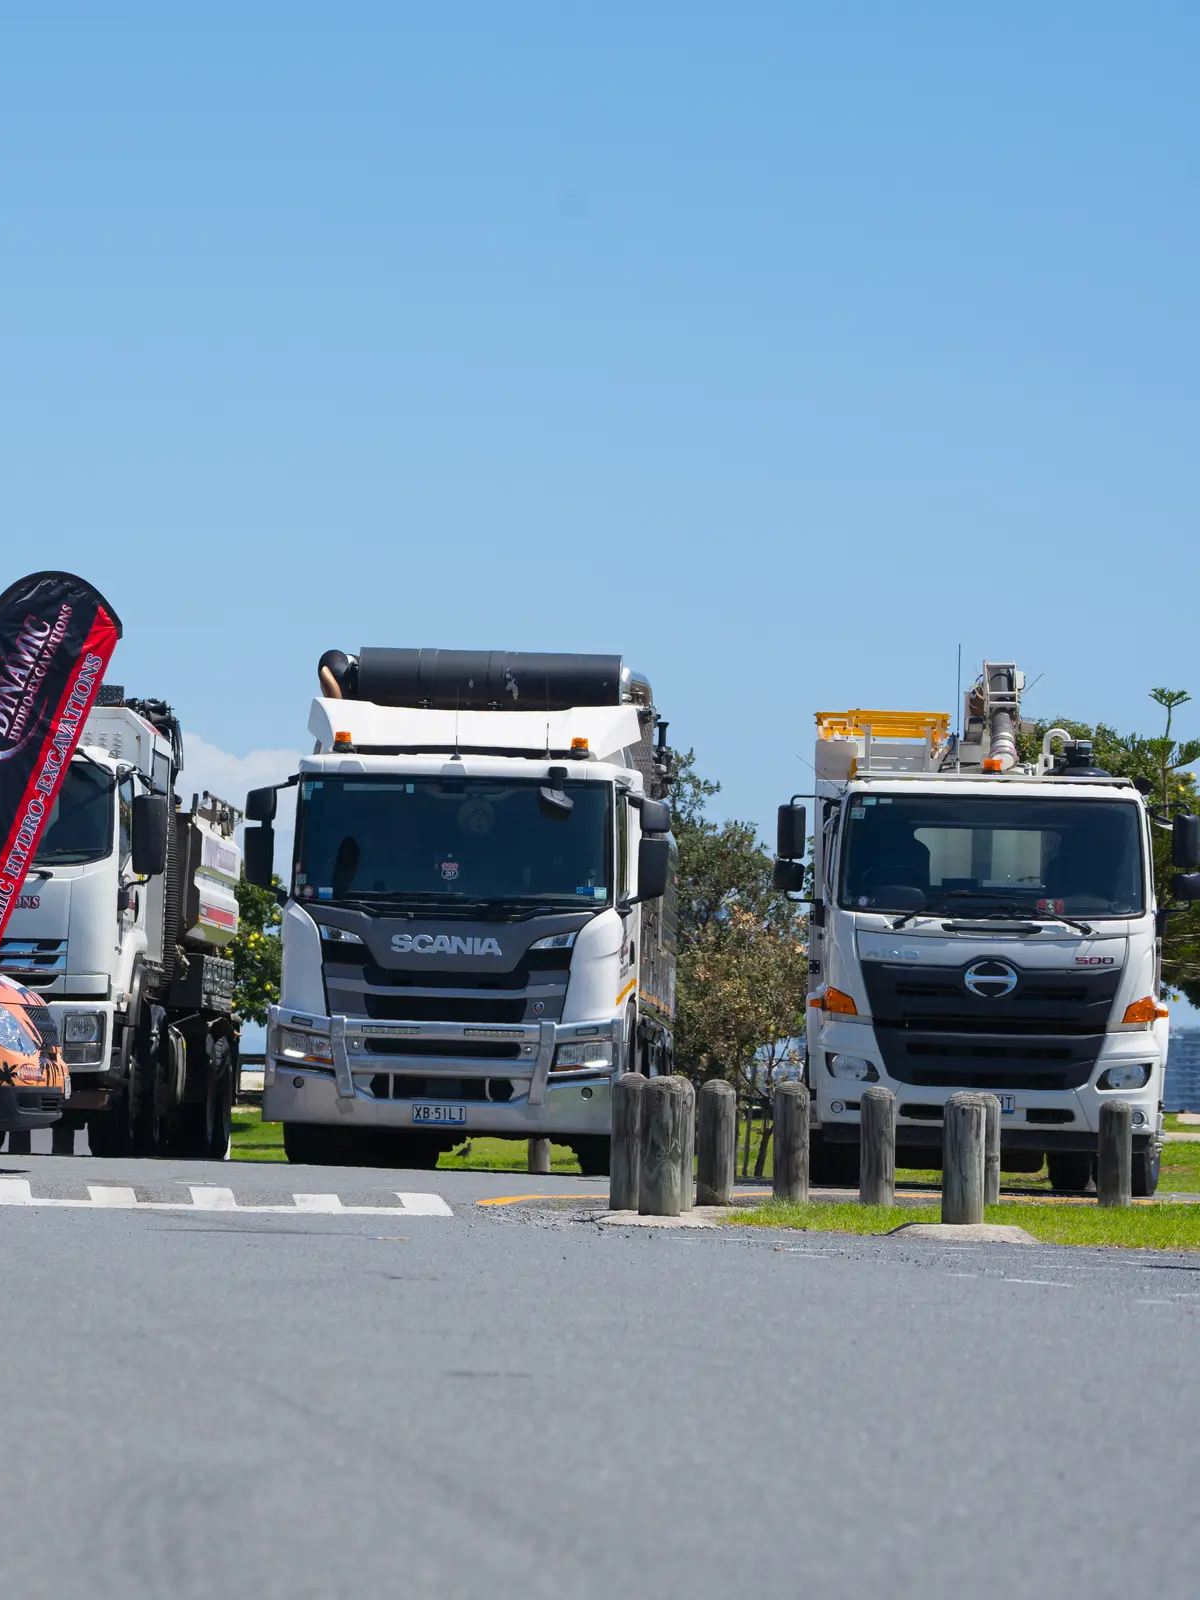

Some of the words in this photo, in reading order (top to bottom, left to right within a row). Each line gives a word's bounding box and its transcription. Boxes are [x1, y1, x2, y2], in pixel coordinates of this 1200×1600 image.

[8, 603, 73, 742] HYDRO-EXCAVATIONS
[2, 652, 103, 880] HYDRO-EXCAVATIONS
[390, 933, 503, 956] SCANIA
[1075, 955, 1116, 965] 500
